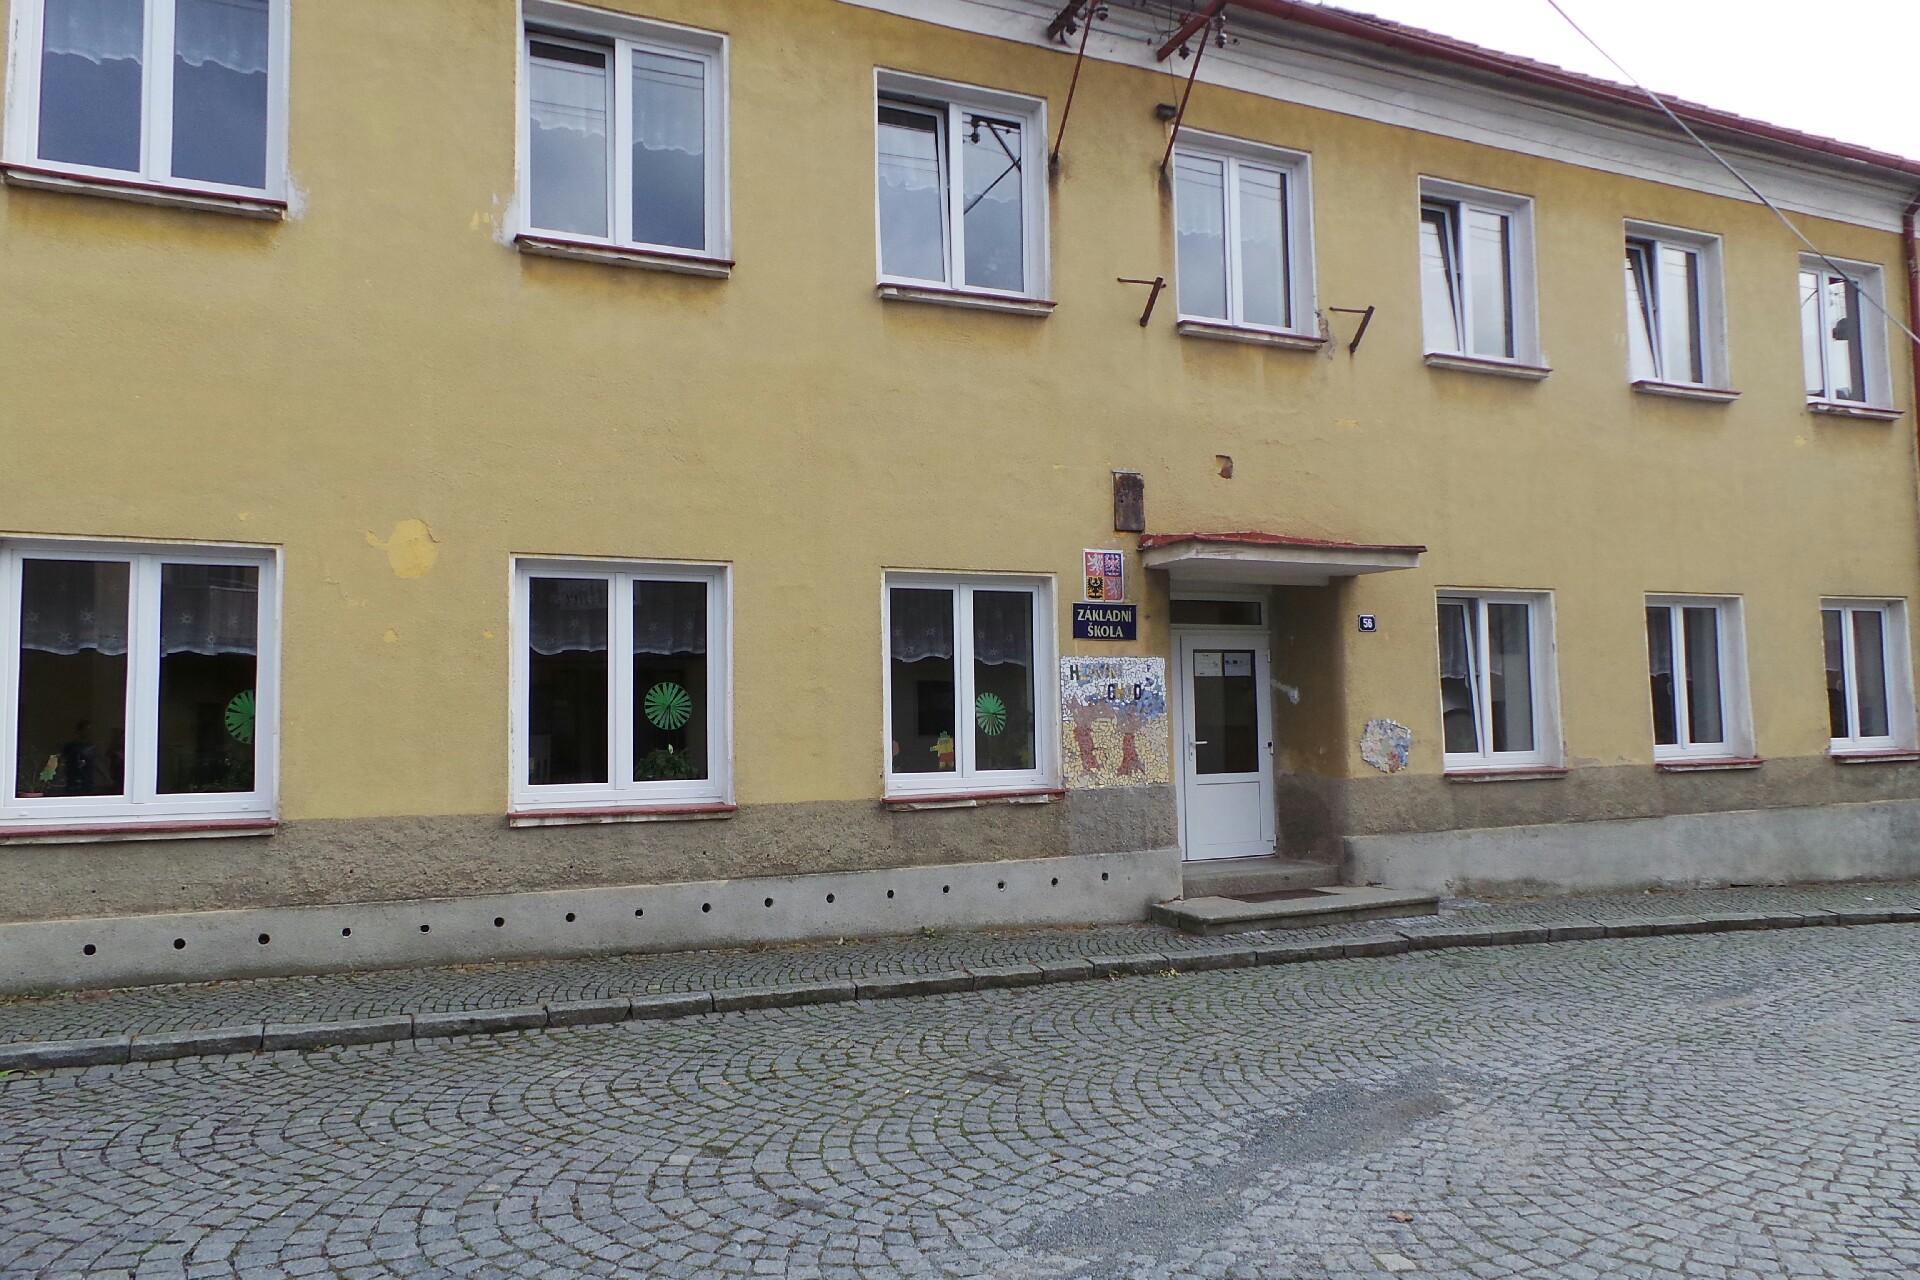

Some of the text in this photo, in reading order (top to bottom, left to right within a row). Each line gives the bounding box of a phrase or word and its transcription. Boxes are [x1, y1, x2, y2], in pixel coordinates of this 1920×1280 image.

[1077, 605, 1132, 622] ZÁKLADNÍ
[1087, 622, 1124, 638] ŠKOLA
[1363, 618, 1373, 628] 56
